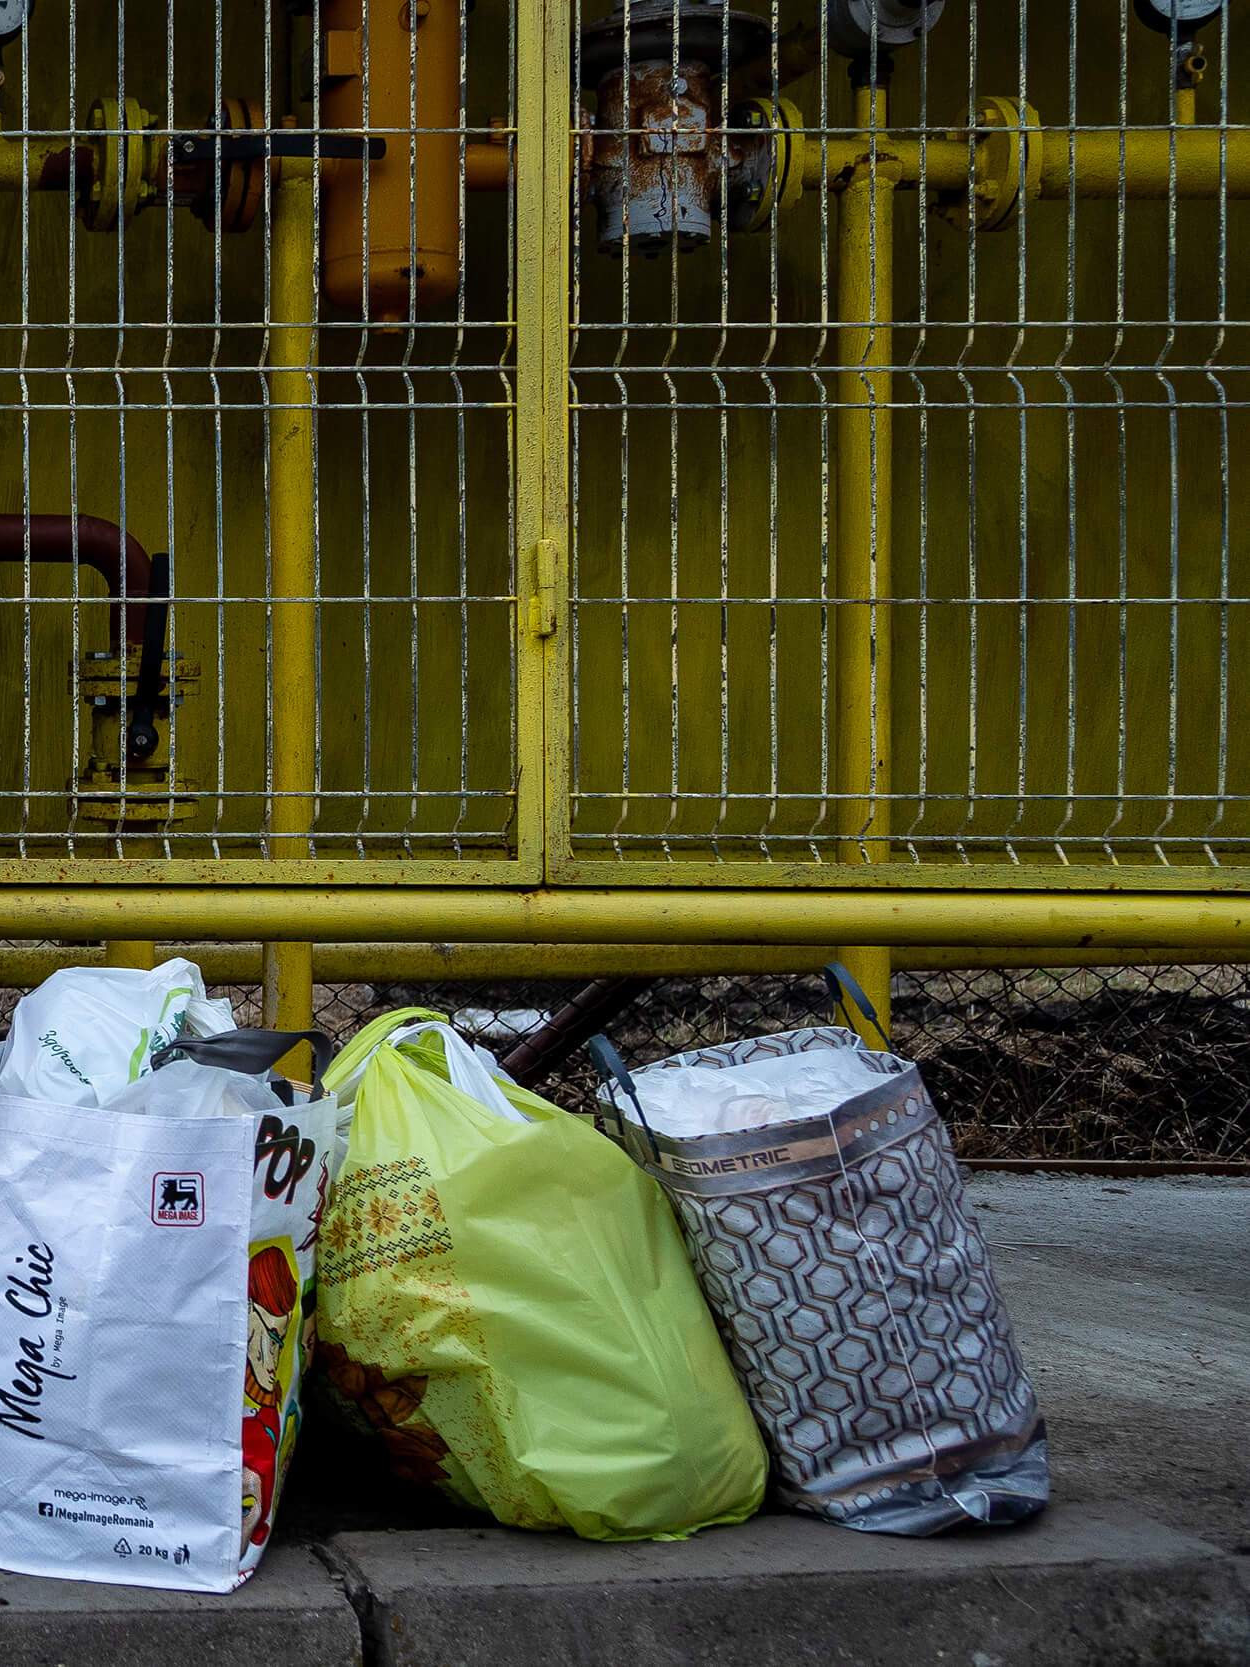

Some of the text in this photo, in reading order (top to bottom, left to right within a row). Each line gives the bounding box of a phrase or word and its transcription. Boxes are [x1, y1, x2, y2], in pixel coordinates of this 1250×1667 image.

[253, 1114, 316, 1206] POP
[672, 1147, 791, 1176] GEOMETRIC
[157, 1210, 199, 1221] MEGA IMAGE
[4, 1240, 55, 1318] Chic
[50, 1296, 69, 1369] by Mega Image
[138, 1544, 153, 1557] 20
[155, 1546, 169, 1560] kg
